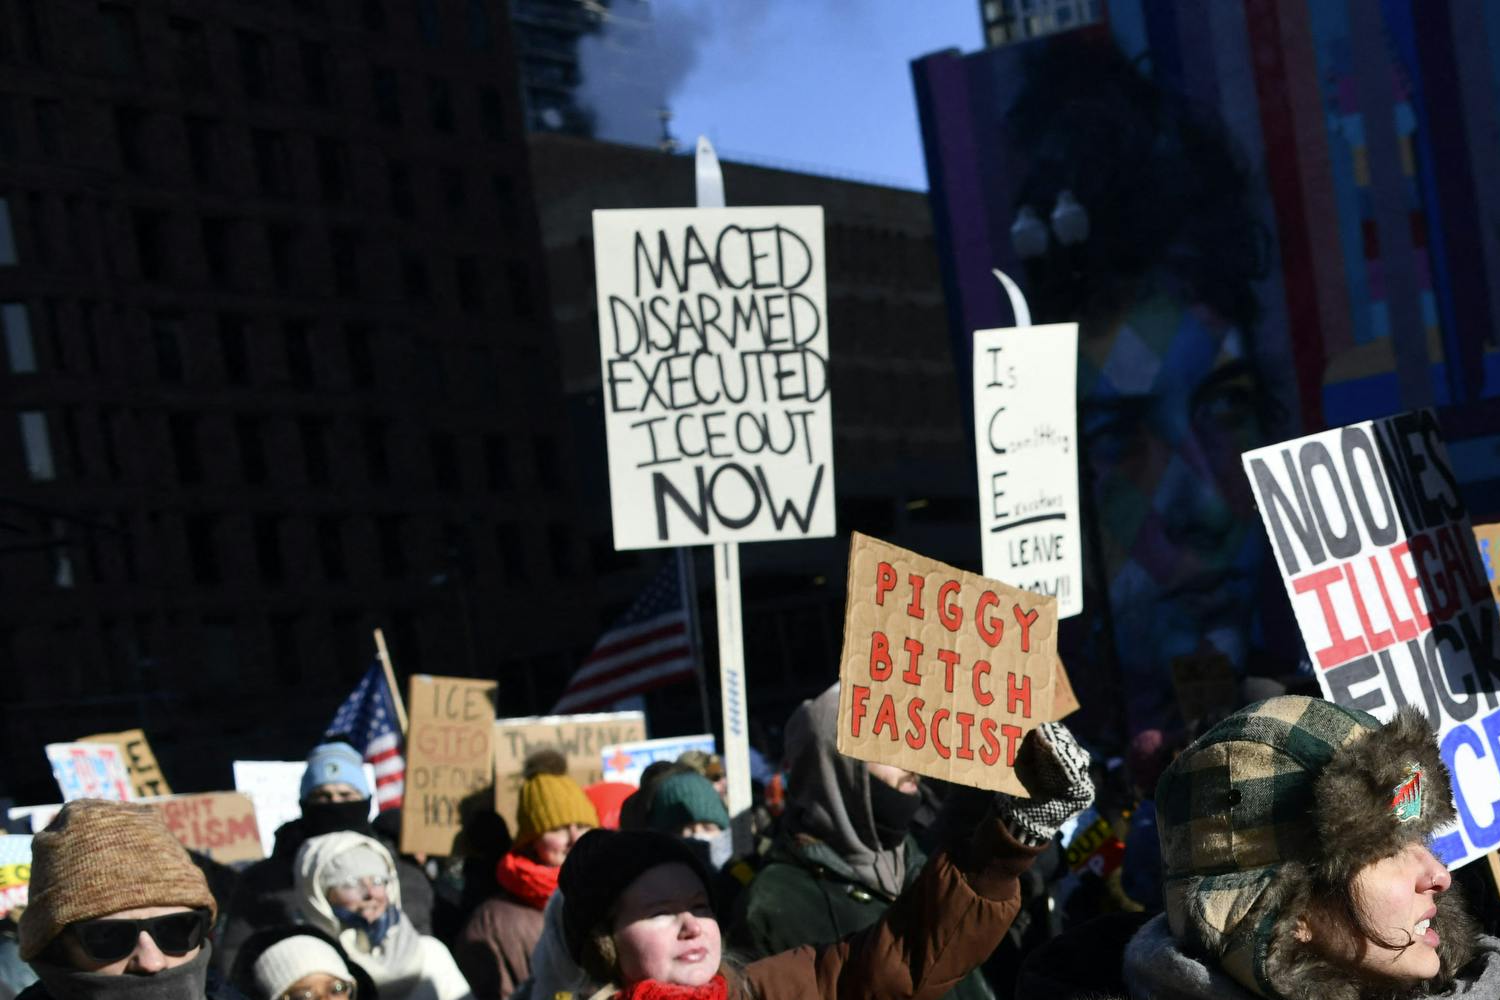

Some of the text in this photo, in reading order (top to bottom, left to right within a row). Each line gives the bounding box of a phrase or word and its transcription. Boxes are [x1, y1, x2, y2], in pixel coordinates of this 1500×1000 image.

[635, 224, 813, 298] MACED
[609, 293, 820, 359] DISARMED
[607, 348, 830, 413] EXECUTED
[652, 462, 825, 541] NOW
[1008, 534, 1064, 568] LEAVE
[875, 561, 1039, 653] PIGGY
[1293, 522, 1491, 669] ILLEGAL
[433, 684, 484, 722] ICE
[869, 631, 1031, 718] BITCH
[416, 724, 489, 760] GTFO
[851, 684, 1022, 767] FASCIST
